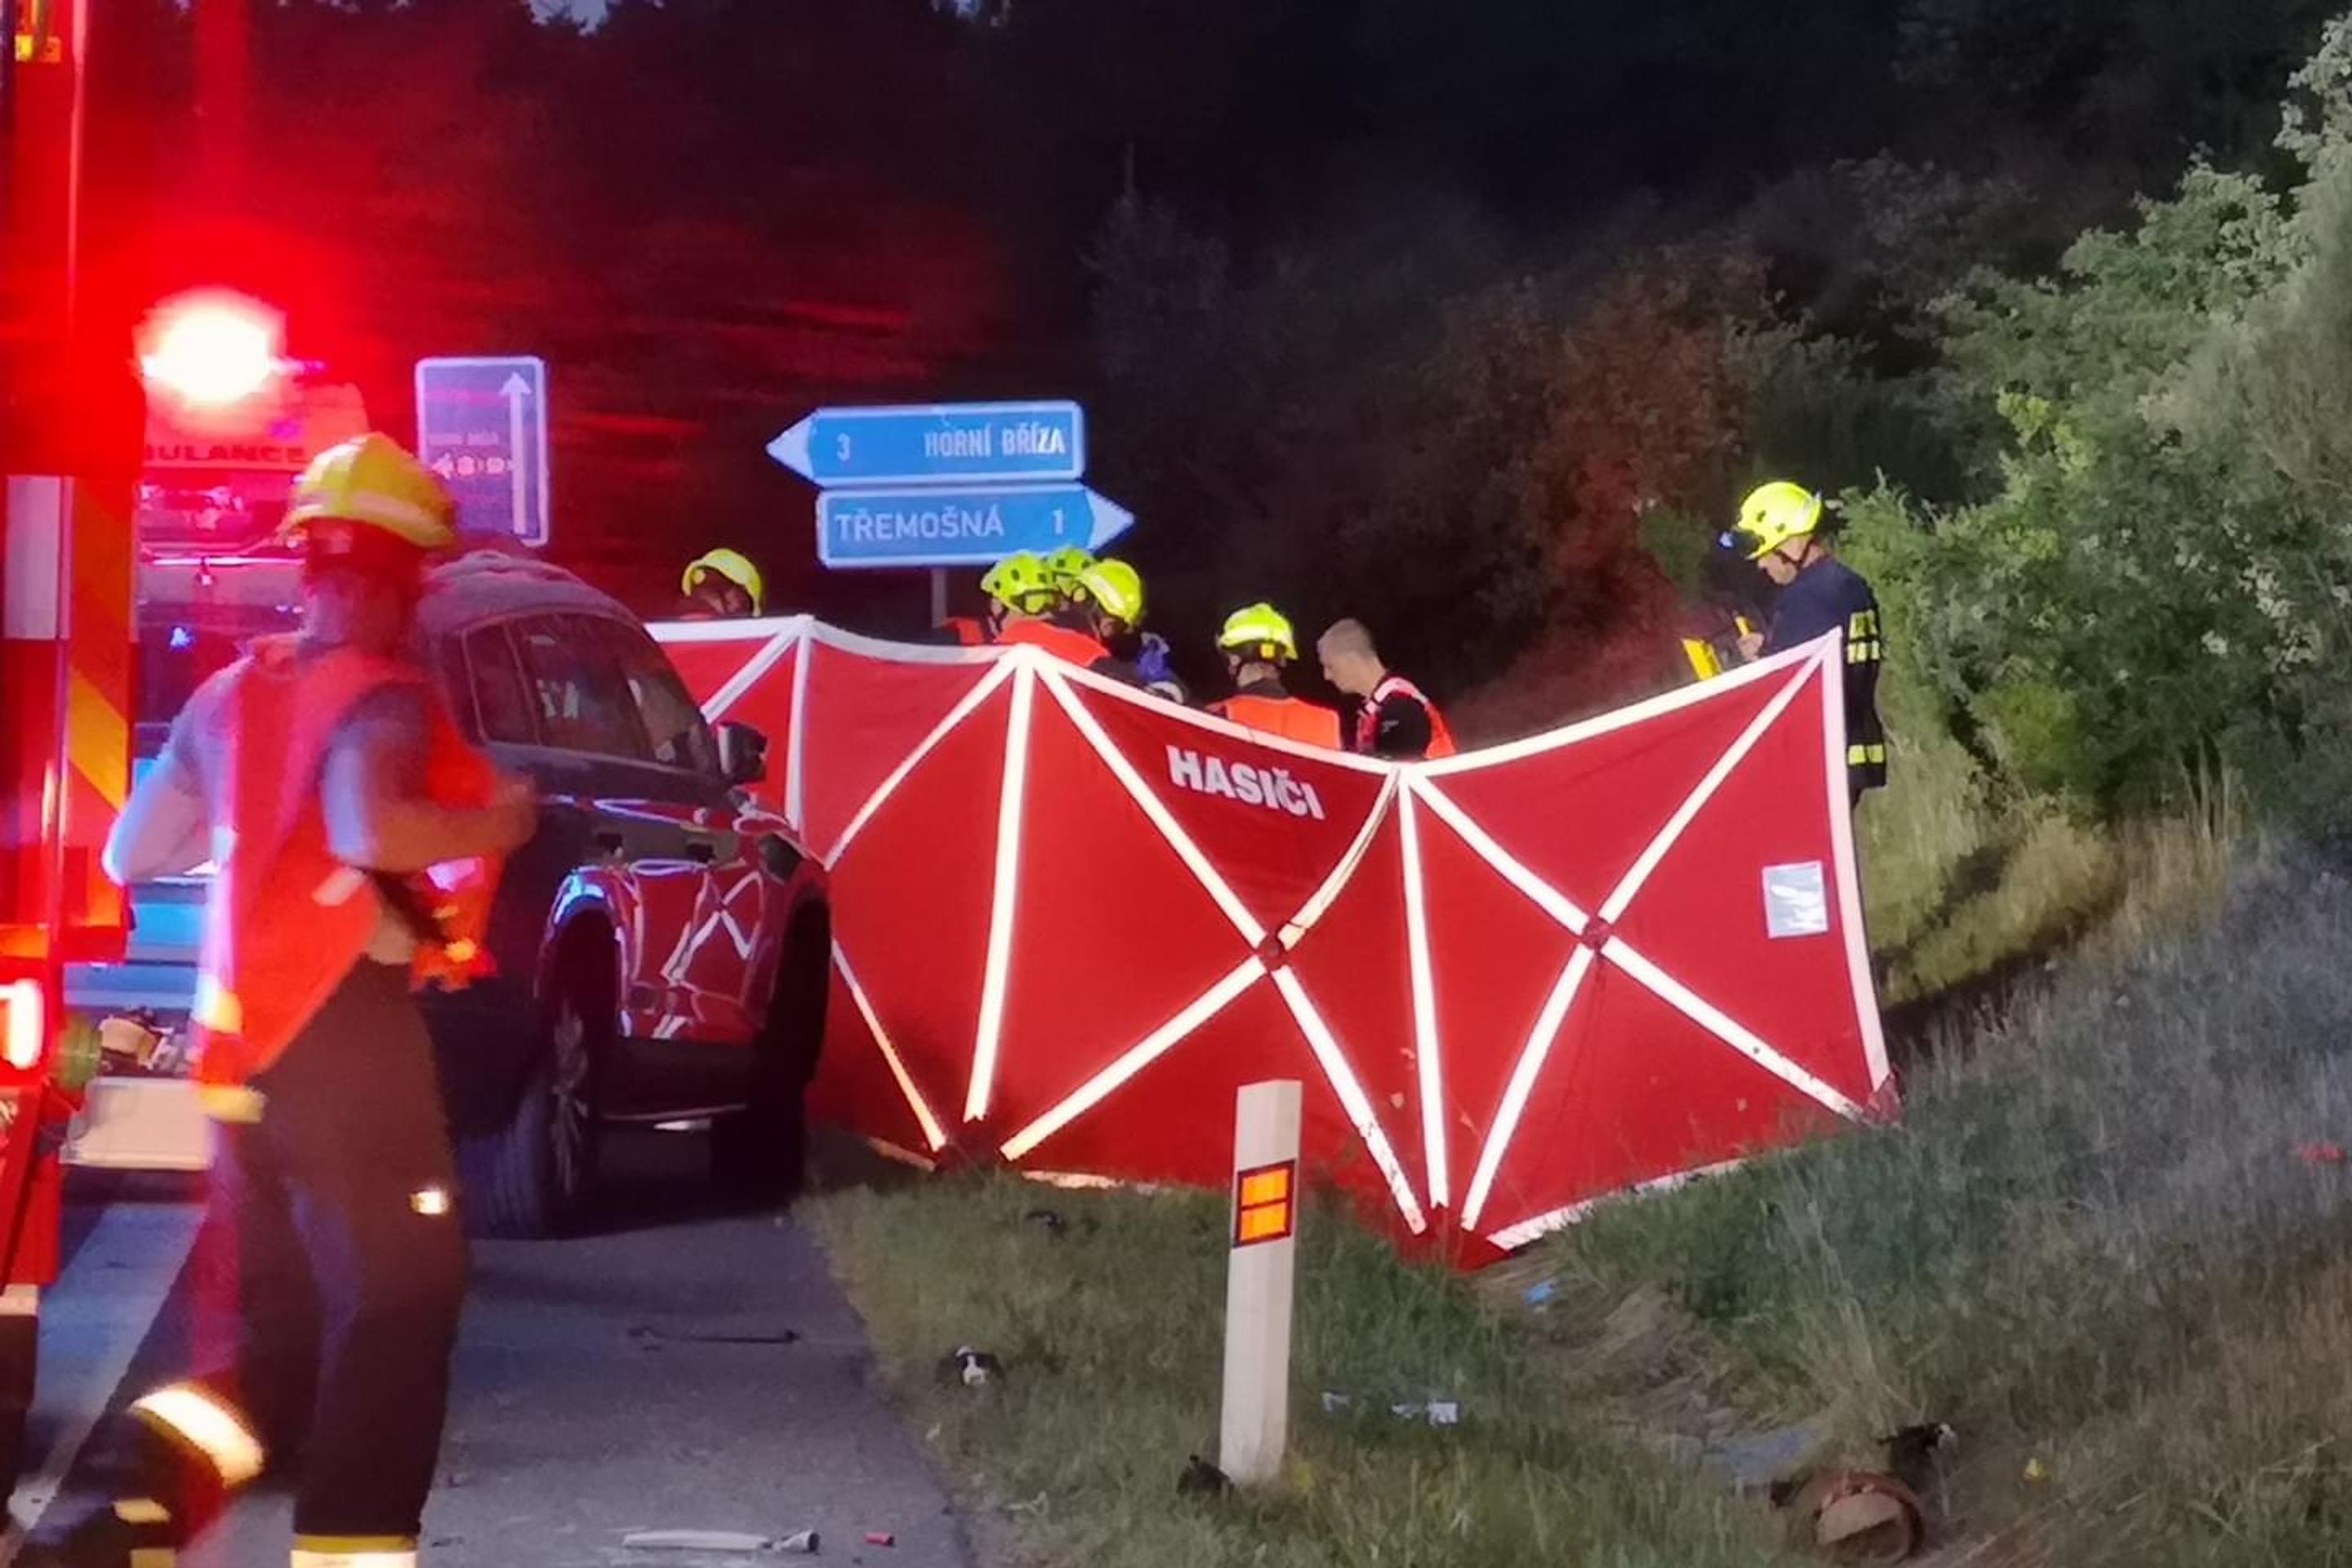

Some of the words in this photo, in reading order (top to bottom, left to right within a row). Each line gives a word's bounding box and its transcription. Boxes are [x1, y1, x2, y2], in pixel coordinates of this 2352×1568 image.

[836, 433, 851, 460] 3
[924, 422, 991, 457] HORNÍ
[1001, 421, 1065, 457] BŘÍZA
[835, 504, 1004, 541] TŘEMOŠNÁ
[1052, 509, 1065, 535] 1
[1165, 745, 1325, 820] HASIČI
